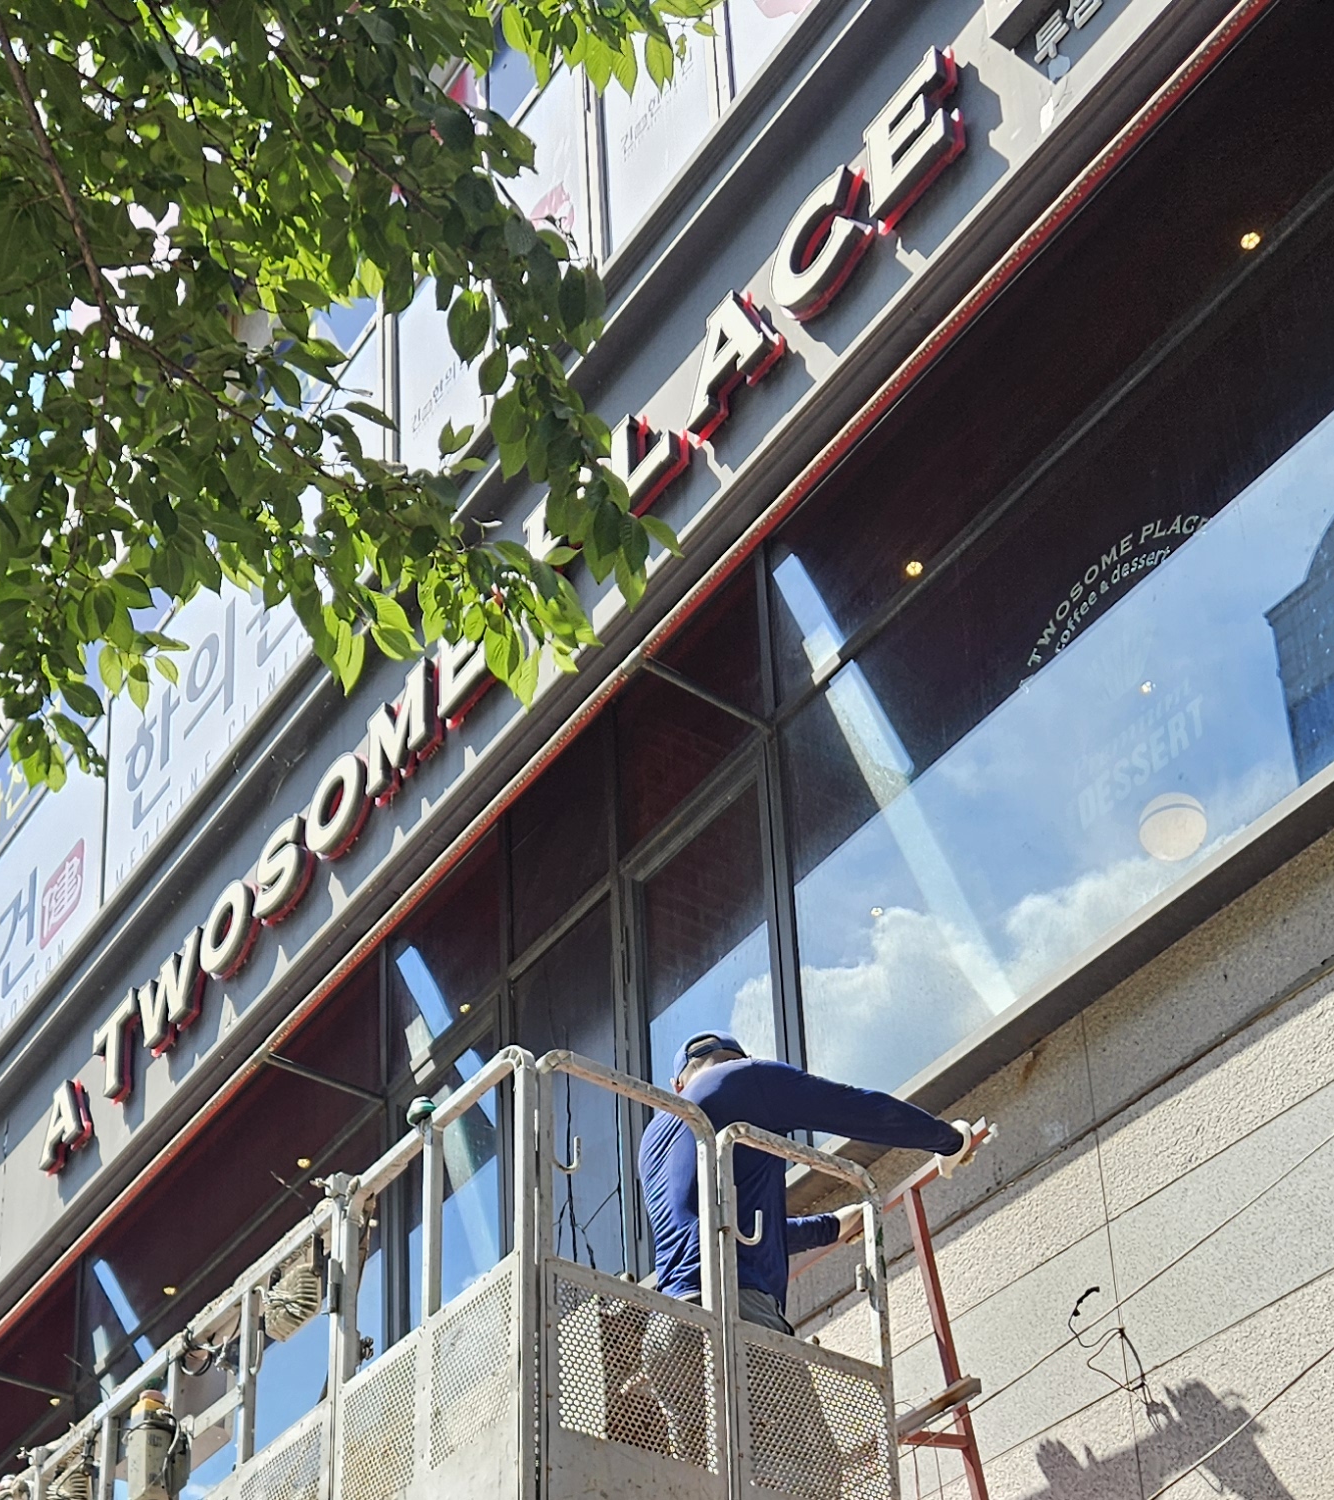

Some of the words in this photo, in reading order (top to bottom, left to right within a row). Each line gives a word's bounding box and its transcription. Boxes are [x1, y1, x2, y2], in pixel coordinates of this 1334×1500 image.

[40, 1078, 93, 1177] A
[94, 632, 499, 1104] TWOSOME
[523, 45, 965, 578] LACE
[1026, 533, 1134, 668] TWOSOME
[1054, 591, 1098, 654] coffee
[1078, 694, 1204, 831] DESSERT
